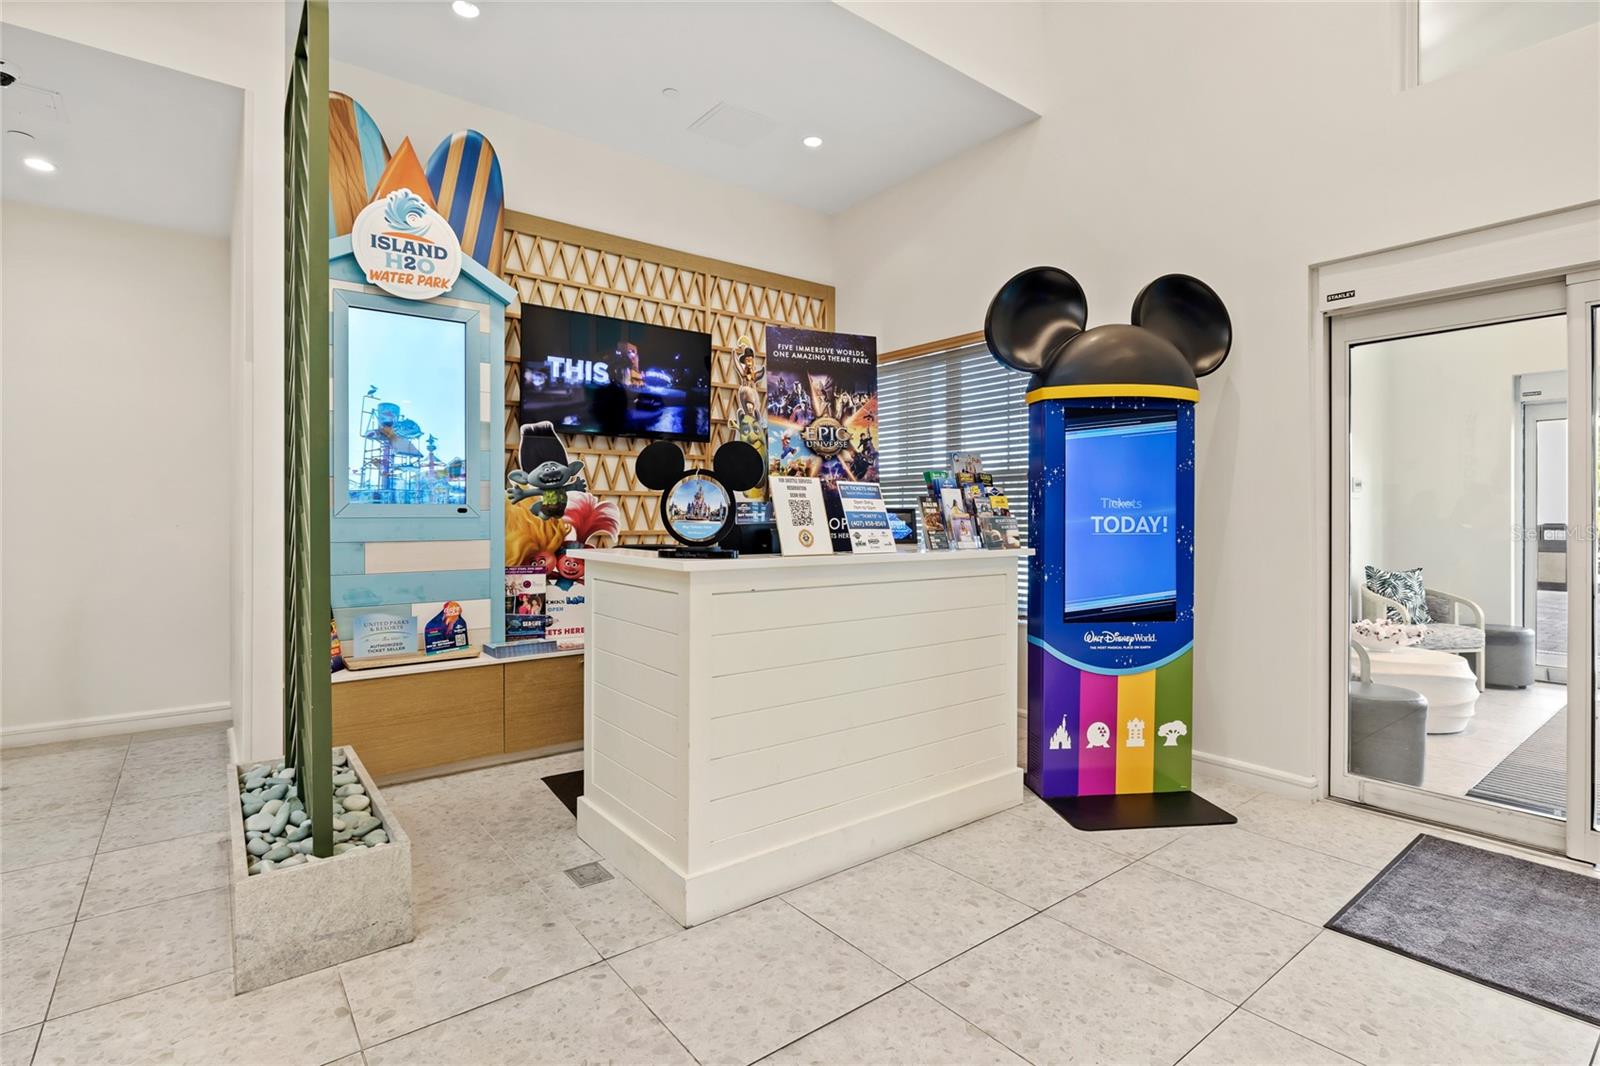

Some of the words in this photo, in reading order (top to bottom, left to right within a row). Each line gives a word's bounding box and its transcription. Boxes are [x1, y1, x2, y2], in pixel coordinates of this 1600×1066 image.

[370, 233, 448, 260] ISLAND
[385, 251, 435, 275] H2O
[369, 270, 415, 285] WATER
[417, 274, 450, 289] PARK
[1327, 291, 1355, 301] STANLEY
[773, 350, 790, 358] ONE
[791, 352, 827, 361] AMAZING
[828, 355, 851, 363] THEME
[852, 357, 872, 365] PARK.
[778, 343, 793, 351] FIVE
[796, 344, 834, 355] IMMERSIVE
[836, 349, 867, 357] WORLDS.
[547, 355, 610, 385] THIS
[805, 426, 849, 441] EPIC
[806, 440, 848, 449] UNIVERSE
[1100, 497, 1142, 509] Tickets
[851, 520, 865, 528] (407)
[1090, 516, 1168, 534] TODAY!
[1083, 630, 1103, 644] Walt
[1101, 630, 1135, 647] Disney
